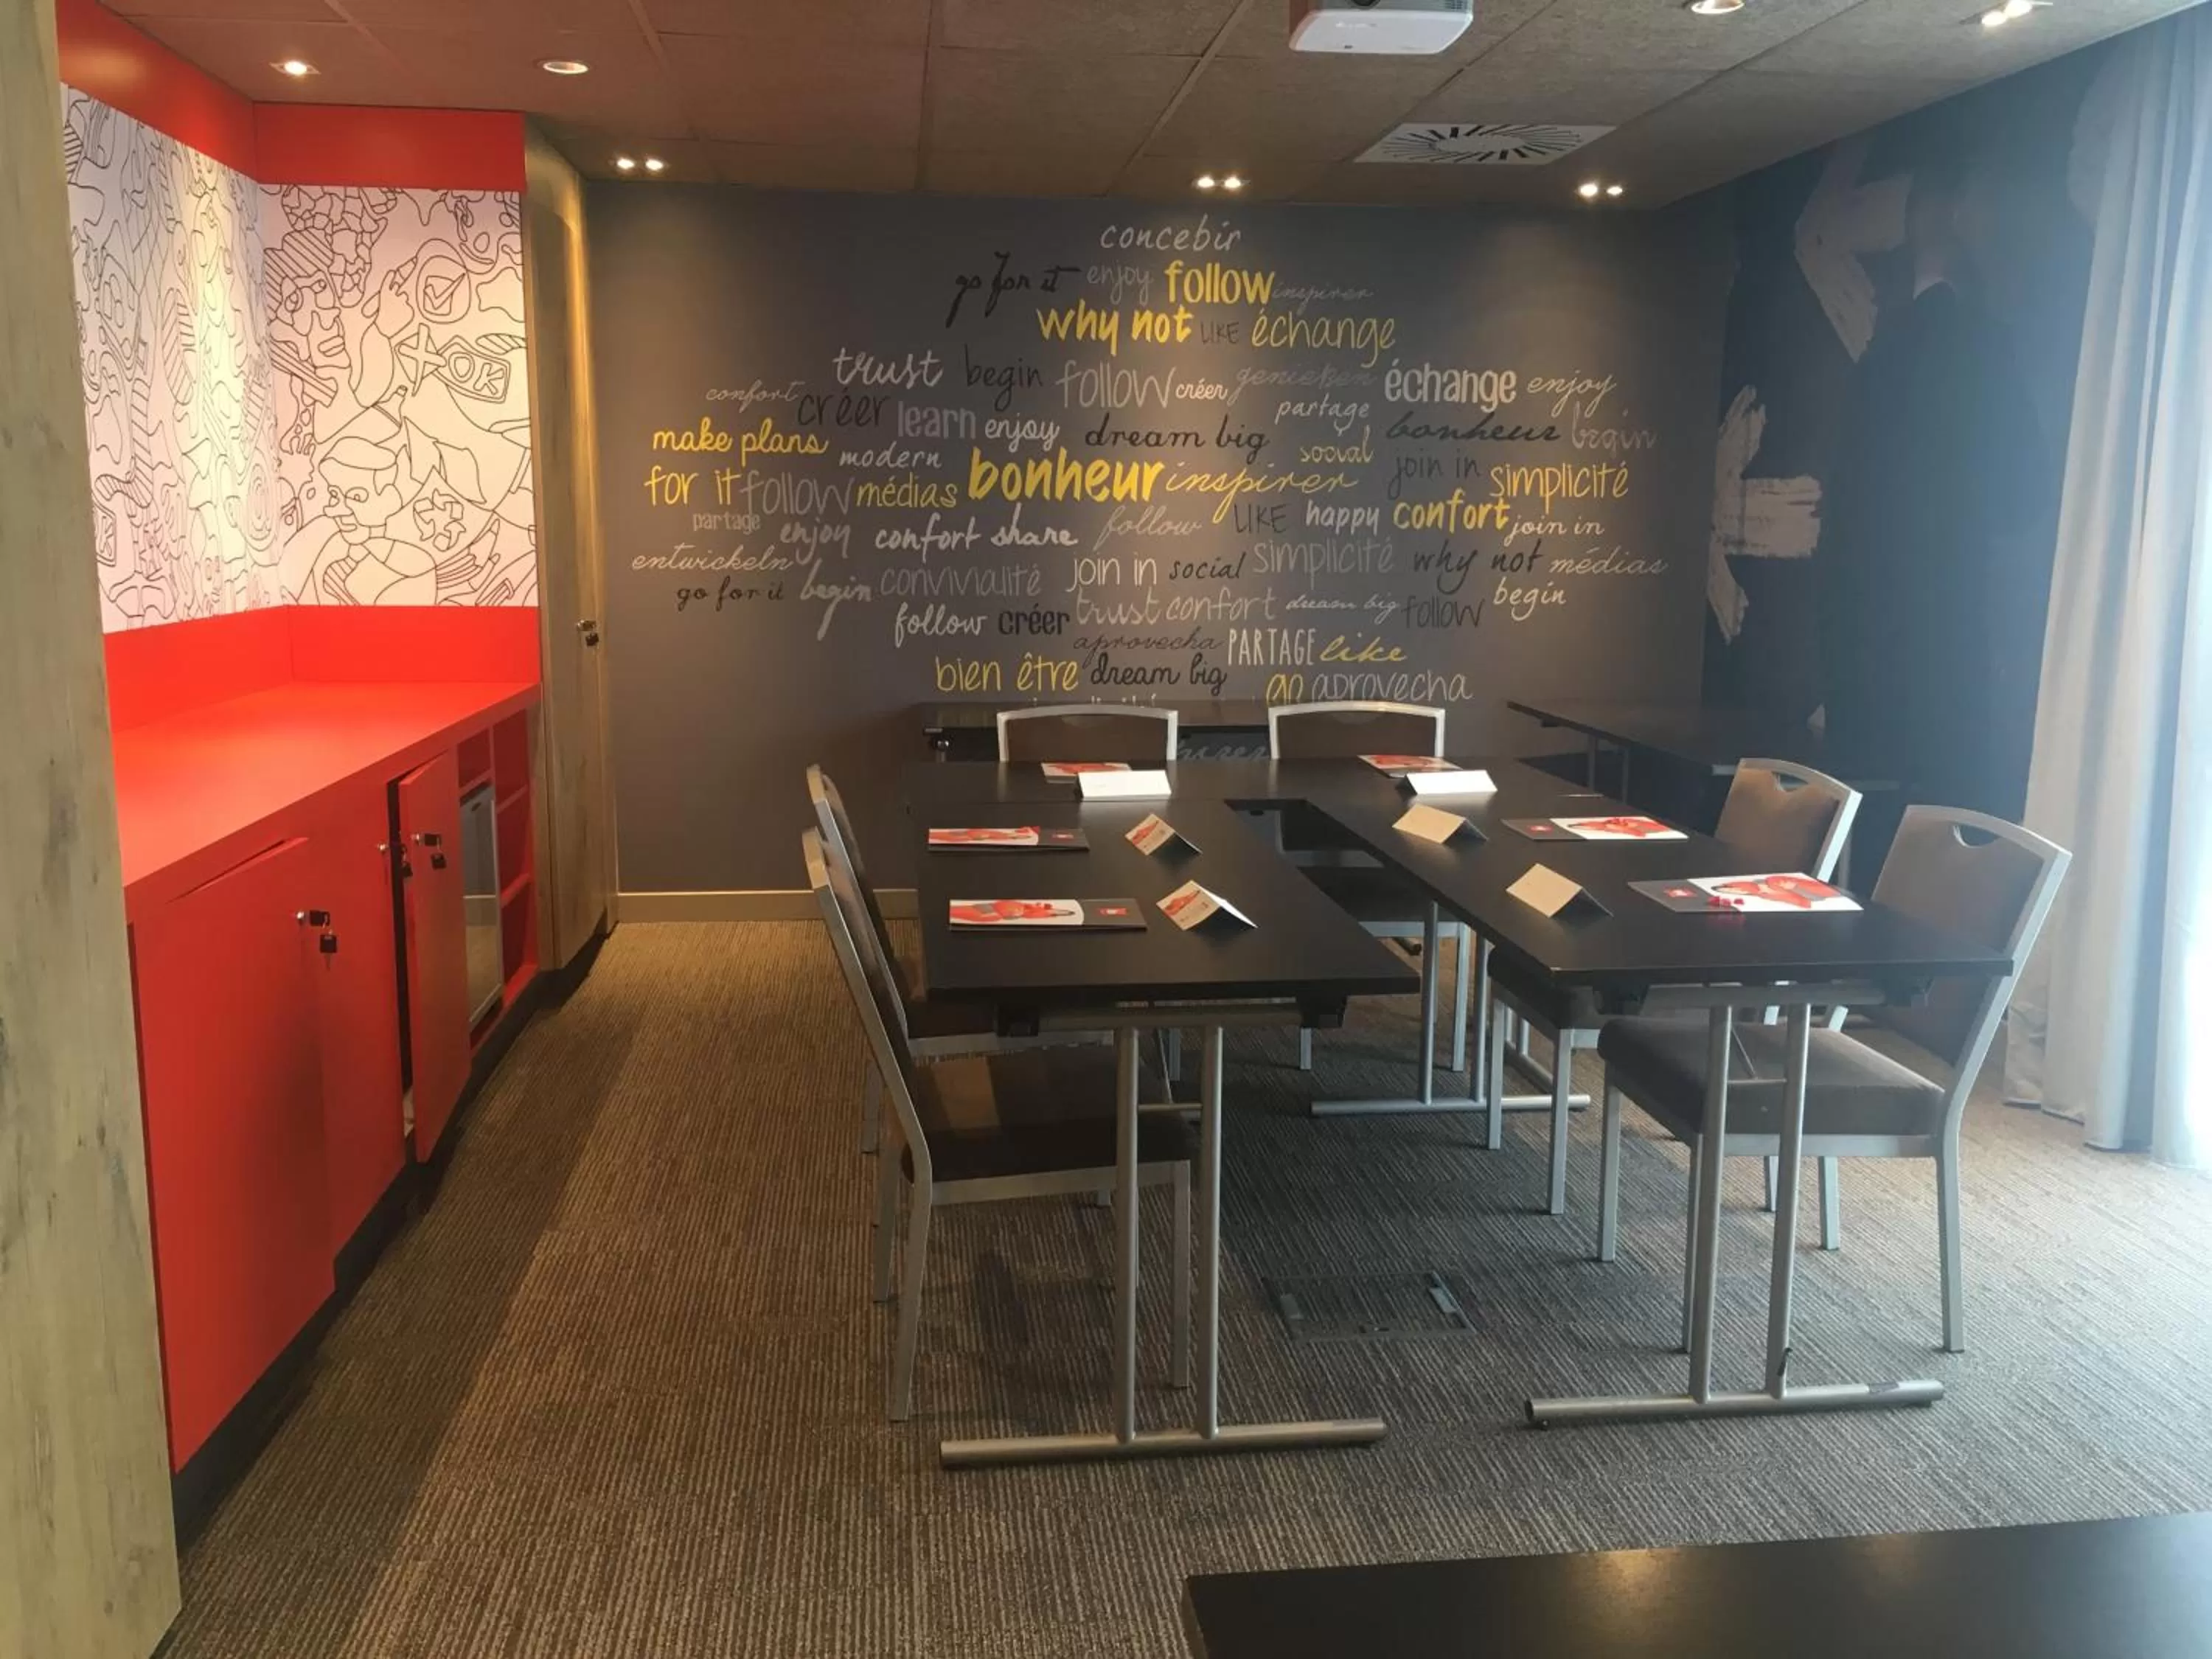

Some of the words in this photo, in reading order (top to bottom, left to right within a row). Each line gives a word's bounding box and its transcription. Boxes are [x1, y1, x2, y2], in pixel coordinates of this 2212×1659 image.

[1100, 214, 1242, 251] concebir
[946, 274, 981, 328] go
[985, 251, 1031, 317] for
[1040, 265, 1082, 293] it
[1087, 260, 1153, 305] enjoy
[1164, 260, 1274, 305] follow
[1037, 299, 1118, 355] why
[1131, 305, 1194, 343] not
[1200, 320, 1240, 346] LIKE
[1251, 307, 1396, 366] échange
[448, 351, 505, 395] OK
[832, 347, 944, 389] trust
[966, 344, 1044, 411] begin
[1055, 360, 1177, 410] follow
[1384, 359, 1517, 413] échange
[706, 378, 805, 413] confort
[798, 389, 890, 427] créer
[1175, 380, 1229, 401] créer
[1527, 369, 1617, 417] enjoy
[898, 401, 976, 439] learn
[985, 417, 1060, 452] enjoy
[1276, 392, 1370, 436] partage
[1386, 411, 1561, 441] bonheur
[1572, 401, 1658, 456] begin
[653, 417, 734, 453] make
[741, 418, 829, 467] plans
[840, 442, 942, 468] modern
[1085, 413, 1206, 449] dream
[1216, 414, 1270, 465] big
[1301, 425, 1374, 463] social
[644, 465, 699, 508] for
[715, 467, 742, 506] it
[740, 470, 855, 517] follow
[855, 473, 958, 508] médias
[968, 447, 1165, 503] bonheur
[1166, 460, 1360, 524] inspirer
[1387, 448, 1444, 501] join
[1455, 449, 1481, 478] in
[1489, 460, 1630, 516] simplicité
[693, 511, 761, 535] partage
[1094, 507, 1202, 552] follow
[1234, 503, 1290, 535] LIKE
[1305, 498, 1379, 535] happy
[1394, 487, 1511, 534] confort
[1504, 516, 1567, 546] join
[1574, 514, 1604, 535] in
[780, 518, 850, 564] enjoy
[875, 513, 981, 562] confort
[991, 503, 1078, 548] share
[631, 542, 793, 573] entwickeln
[1066, 552, 1120, 592] join
[1134, 552, 1157, 586] in
[1169, 552, 1246, 580] social
[1254, 537, 1394, 588] simplicité
[1413, 540, 1478, 595] why
[1491, 539, 1543, 574] not
[1548, 546, 1668, 575] médias
[676, 585, 708, 612] go
[716, 577, 762, 611] for
[768, 580, 784, 601] it
[800, 559, 874, 640] begin
[1076, 587, 1166, 625] trust
[1166, 586, 1276, 621] confort
[1363, 591, 1401, 625] big
[1402, 596, 1486, 629] follow
[1493, 577, 1567, 622] begin
[894, 603, 987, 647] follow
[998, 602, 1071, 636] créer
[1074, 627, 1223, 669] aprovecha
[1228, 628, 1316, 667] PARTAGE
[1320, 632, 1407, 663] like
[936, 656, 1001, 692] bien
[1017, 652, 1079, 692] être
[1091, 653, 1180, 686] dream
[1189, 653, 1227, 696] big
